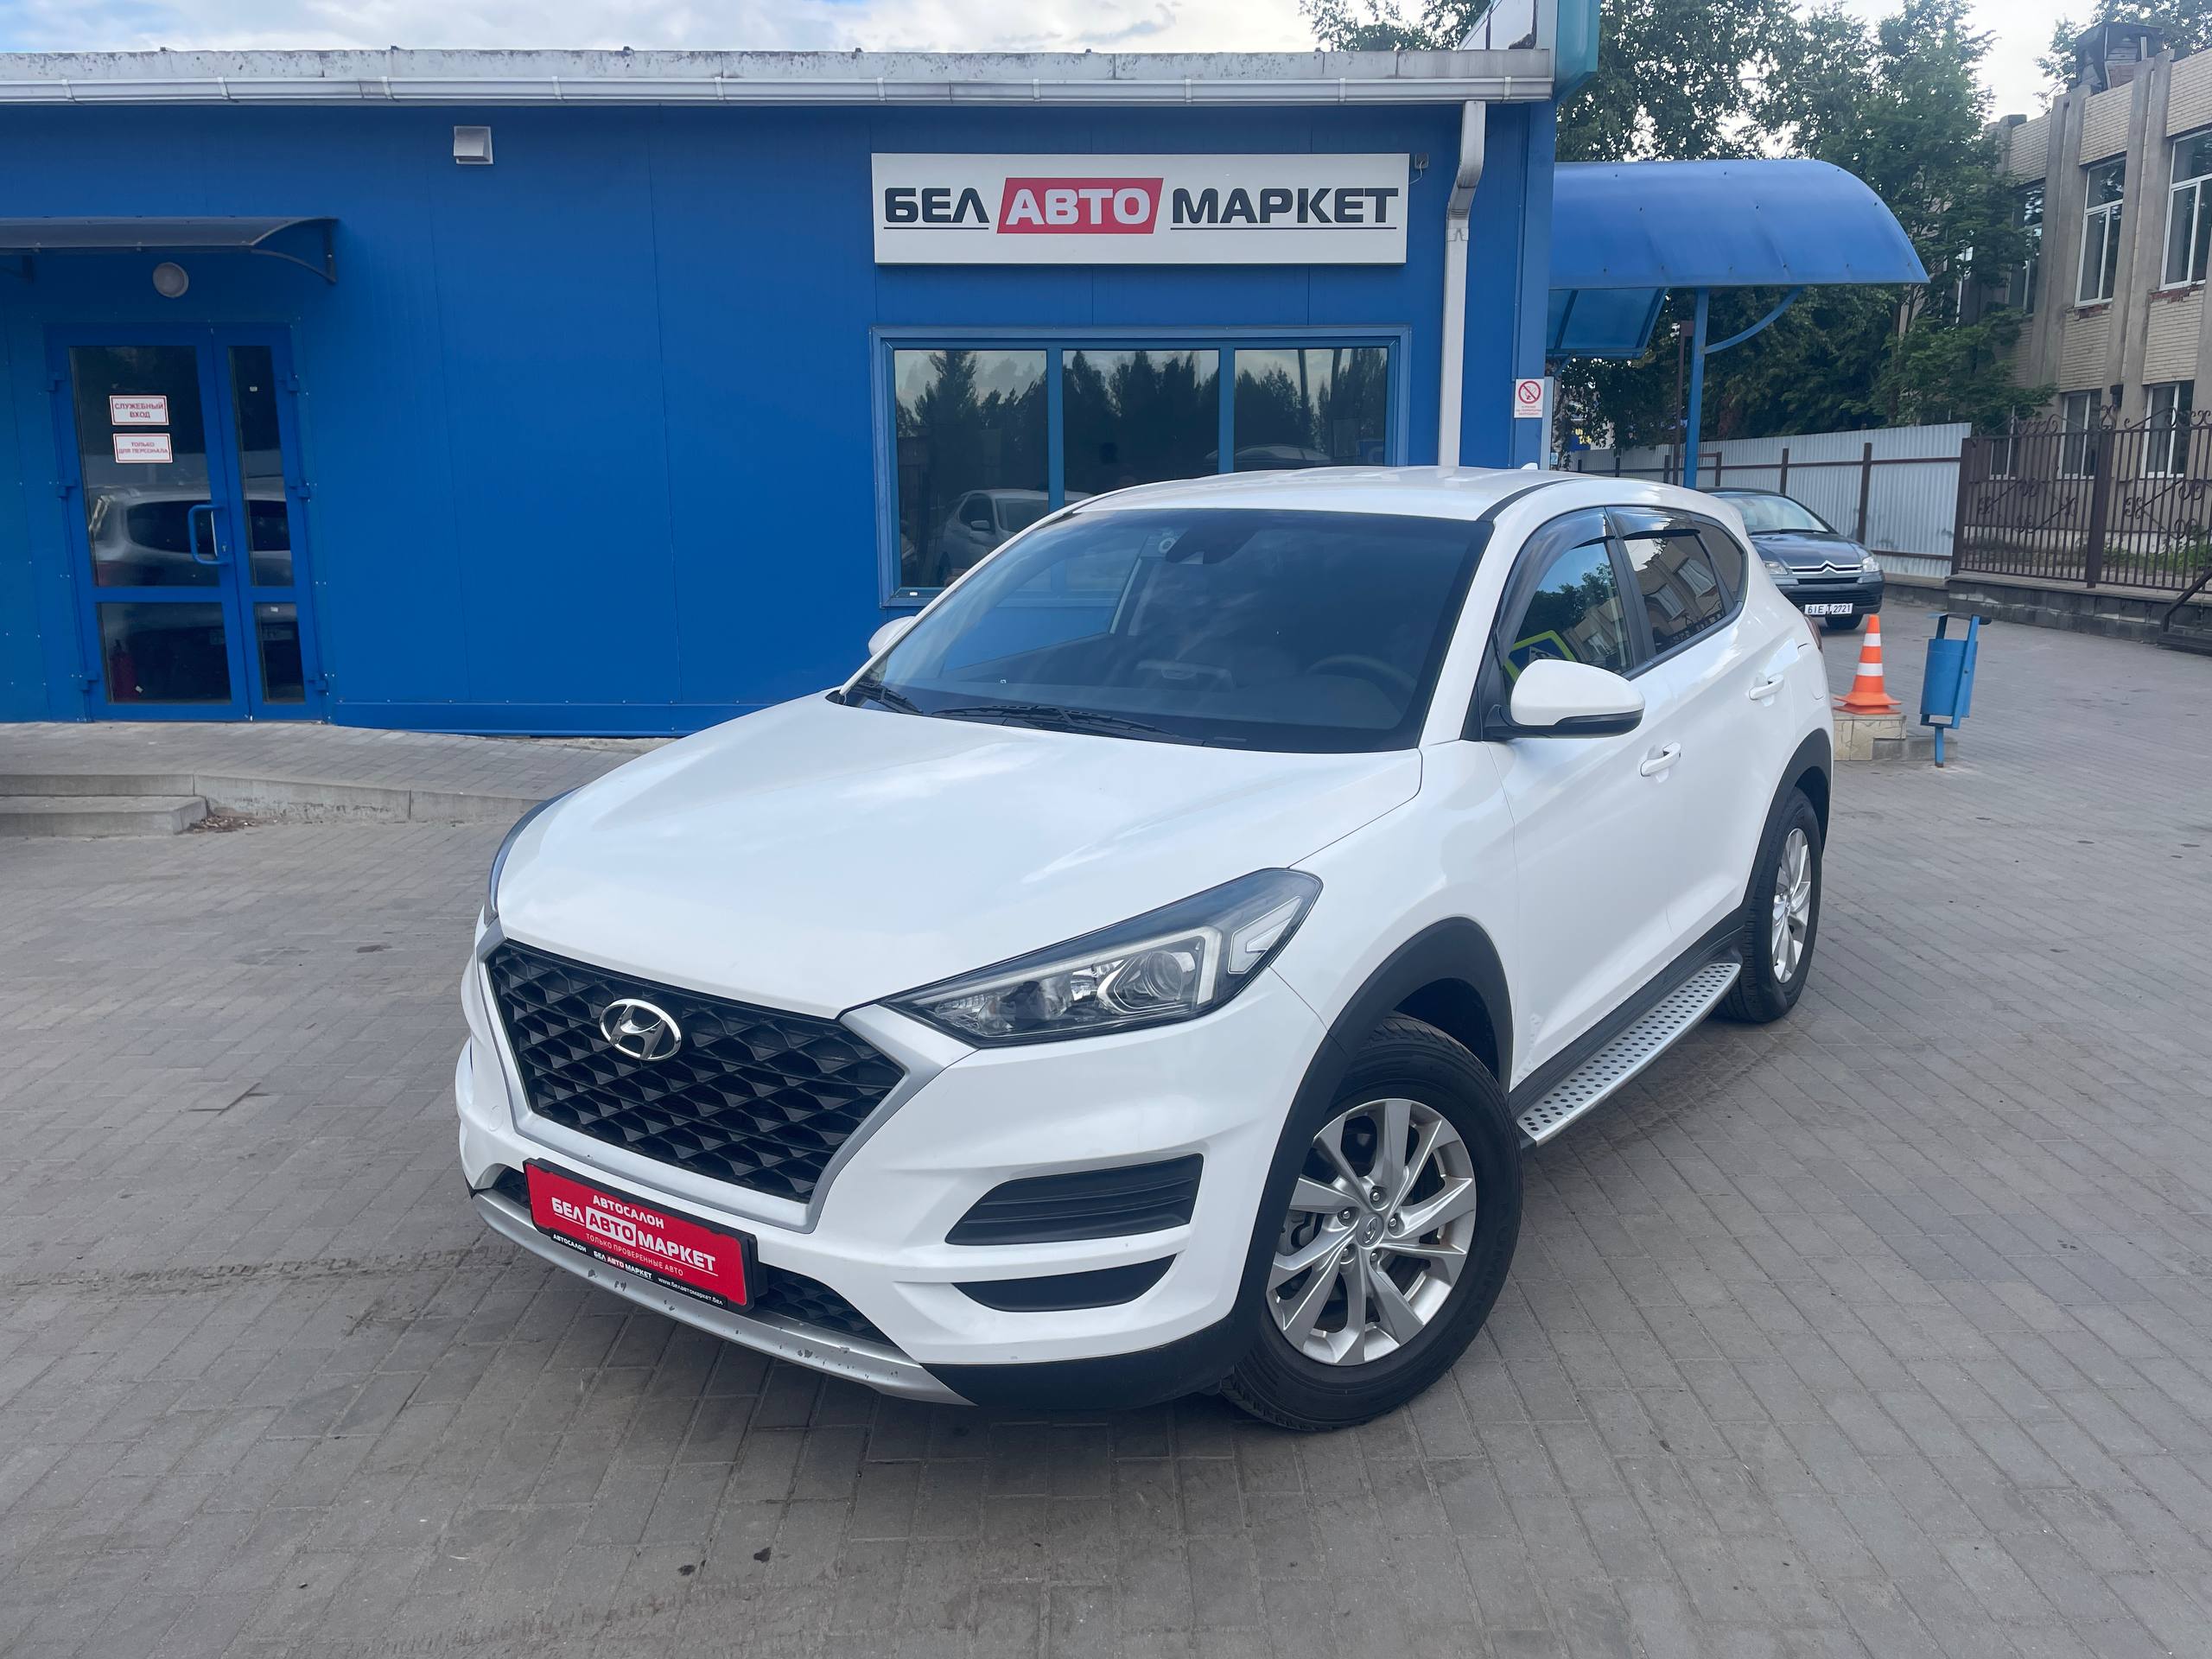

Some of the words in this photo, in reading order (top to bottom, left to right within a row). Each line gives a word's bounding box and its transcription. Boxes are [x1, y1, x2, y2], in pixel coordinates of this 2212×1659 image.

[884, 187, 989, 224] БЕЛ
[1005, 188, 1152, 226] АВТО
[1172, 187, 1399, 225] МАРКЕТ
[551, 1197, 585, 1224] БЕЛ
[588, 1211, 635, 1242] АВТО
[638, 1230, 715, 1271] МАРКЕТ
[593, 1195, 664, 1229] АВТОСАЛОН
[553, 1234, 587, 1252] АВТОСАЛОН
[593, 1249, 607, 1262] БЕЛ
[607, 1255, 626, 1269] АВТО
[625, 1262, 653, 1279] МАРКЕТ
[586, 1232, 613, 1249] ТОЛЬКО
[613, 1245, 664, 1269] ПРОВЕРЕННЫЕ
[664, 1264, 684, 1277] АВТО
